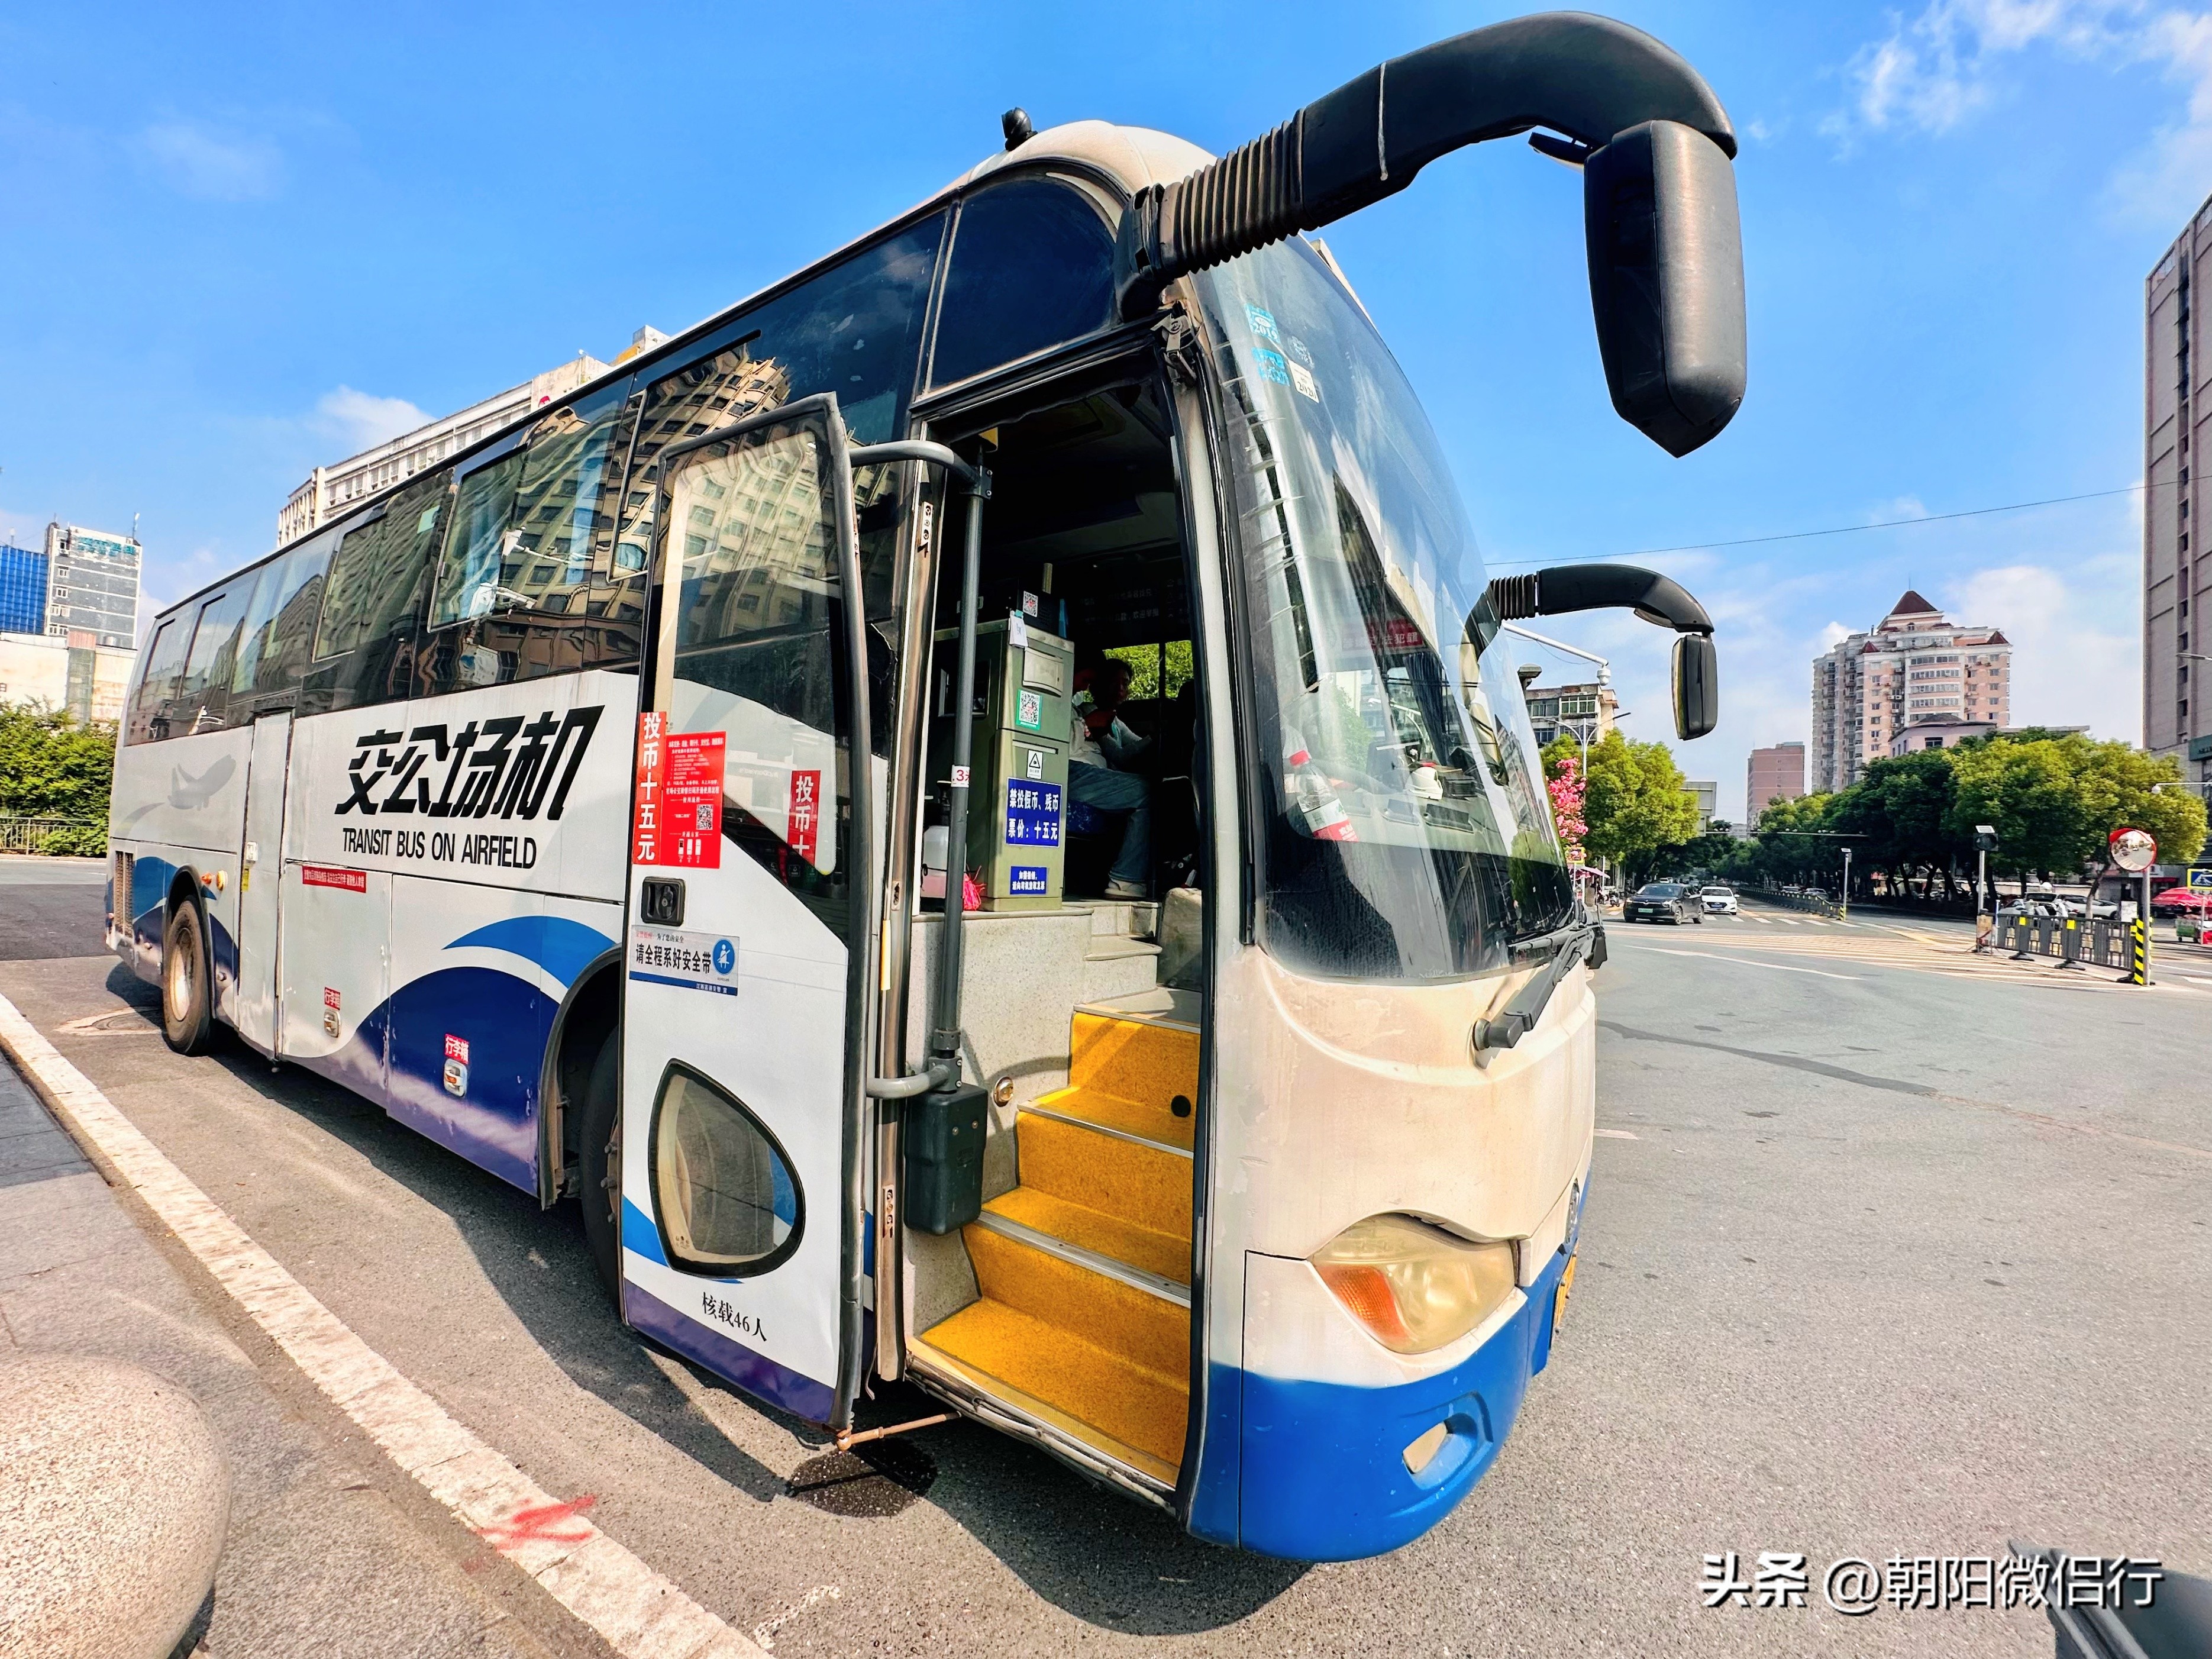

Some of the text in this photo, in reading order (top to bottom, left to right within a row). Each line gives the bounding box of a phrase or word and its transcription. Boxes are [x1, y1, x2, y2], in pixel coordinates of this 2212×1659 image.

[637, 712, 662, 861] 投币十五元
[1009, 788, 1059, 812] 禁投假币、残币
[1008, 818, 1058, 840] 票价：十五元
[343, 827, 537, 870] TRANSIT BUS ON AIRFIELD
[657, 933, 684, 944] 为了您的安全
[636, 943, 711, 974] 请全程系好安全带
[445, 1035, 469, 1063] 行李箱
[702, 1292, 767, 1342] 核载46人
